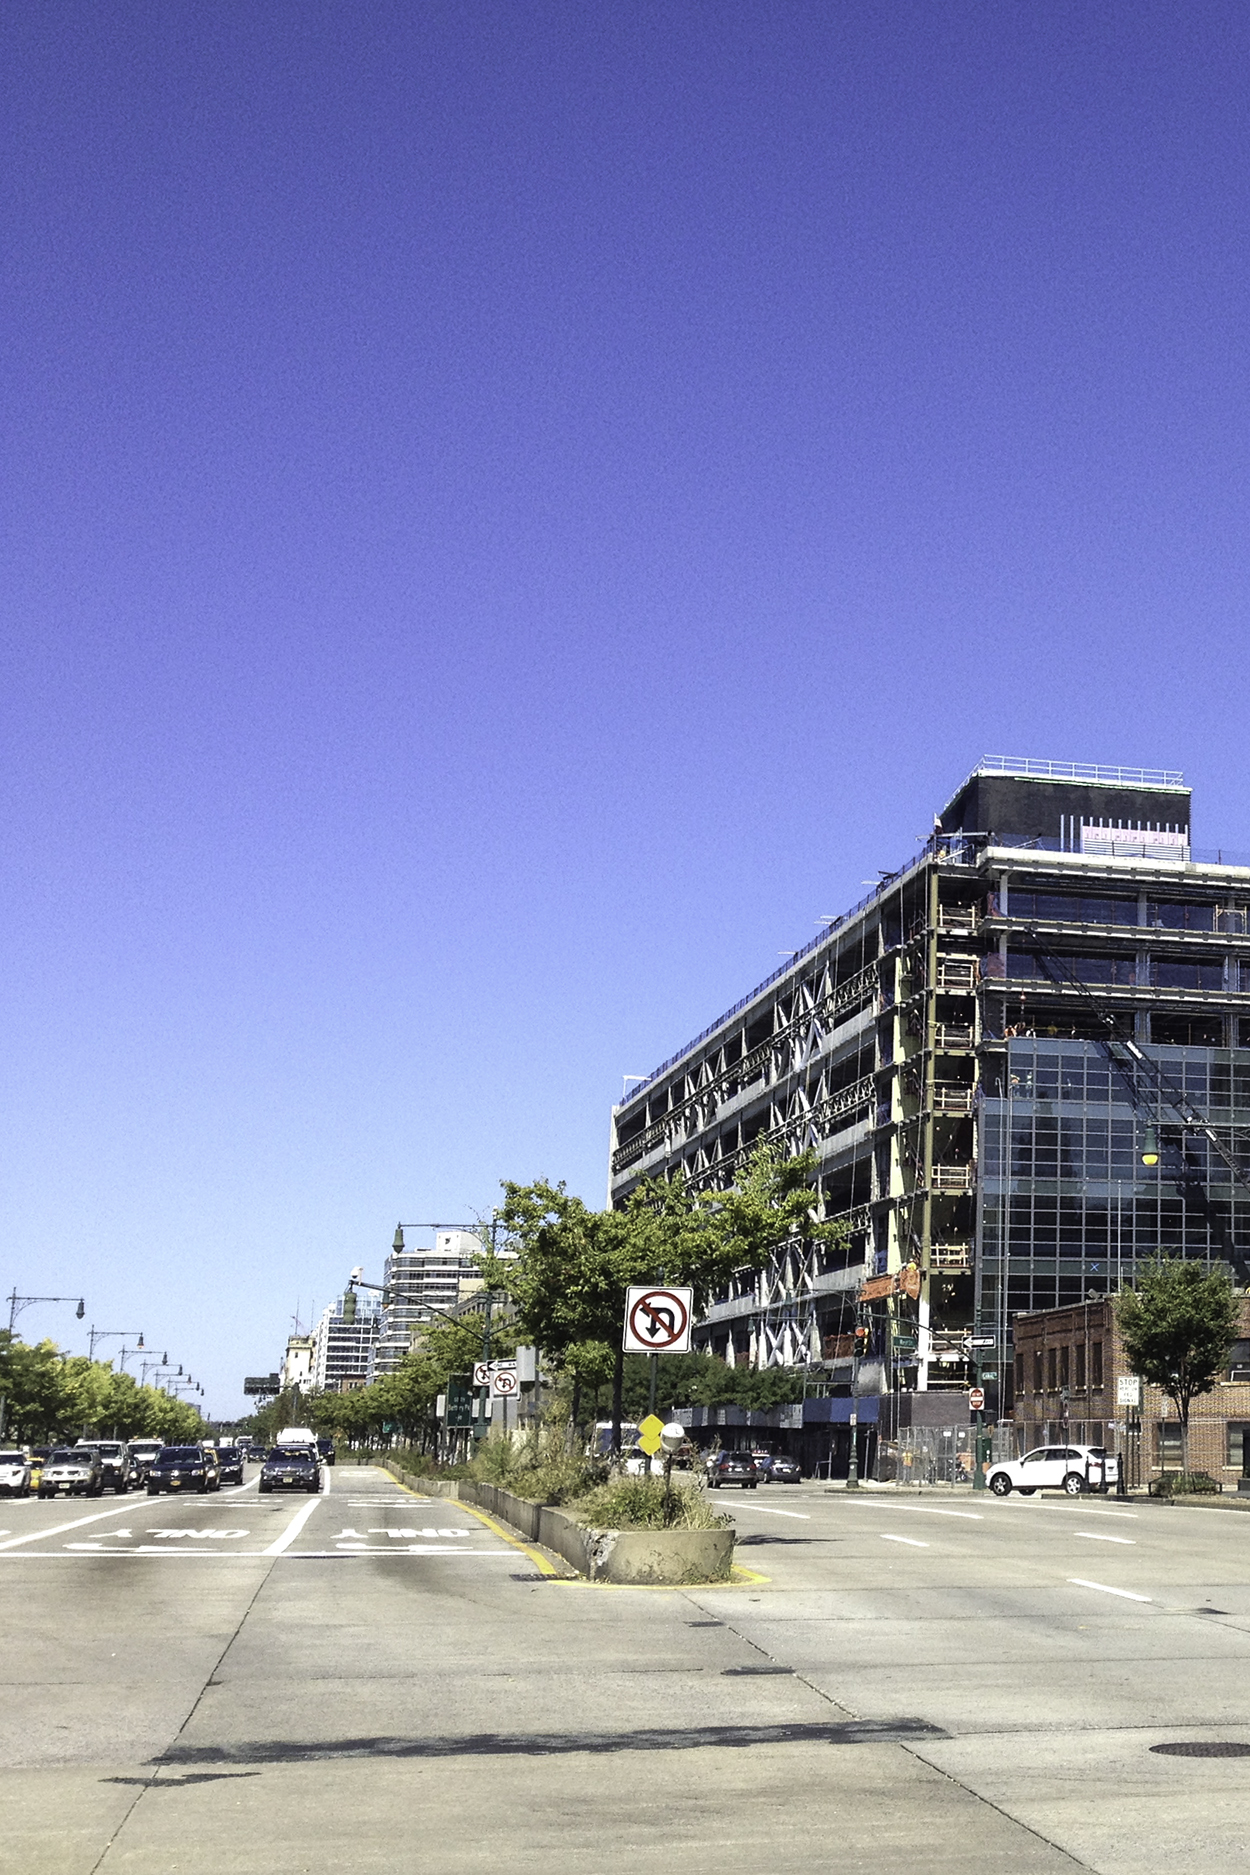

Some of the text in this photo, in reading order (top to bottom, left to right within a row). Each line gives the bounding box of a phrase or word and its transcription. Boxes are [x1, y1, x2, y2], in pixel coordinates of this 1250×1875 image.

[1119, 1378, 1138, 1386] STOP
[89, 1528, 251, 1539] ONLY
[331, 1528, 470, 1539] ONLY
